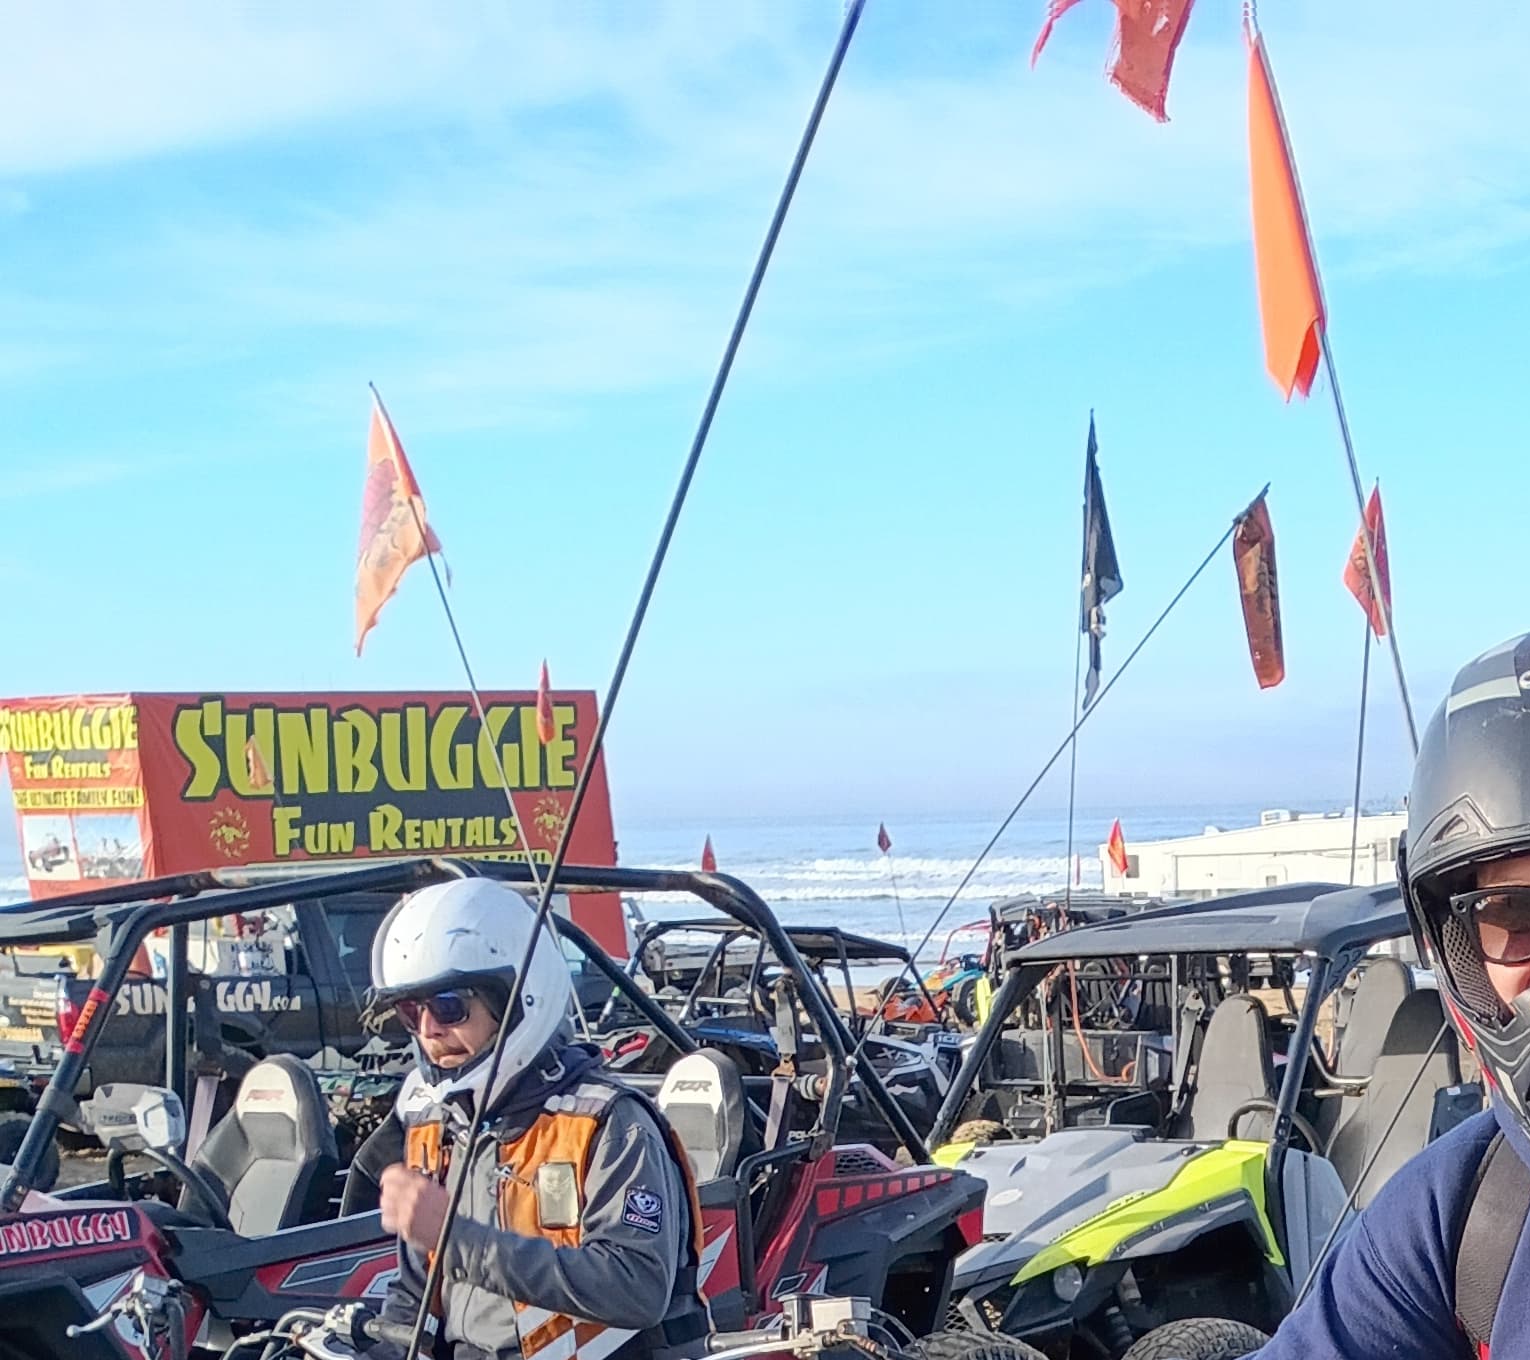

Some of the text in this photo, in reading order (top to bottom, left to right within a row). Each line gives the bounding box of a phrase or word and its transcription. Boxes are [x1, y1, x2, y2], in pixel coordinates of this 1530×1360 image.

[176, 699, 577, 798] SUNBUGGIE
[272, 803, 518, 857] FUN RENTALS
[0, 1210, 131, 1255] NBUGGY
